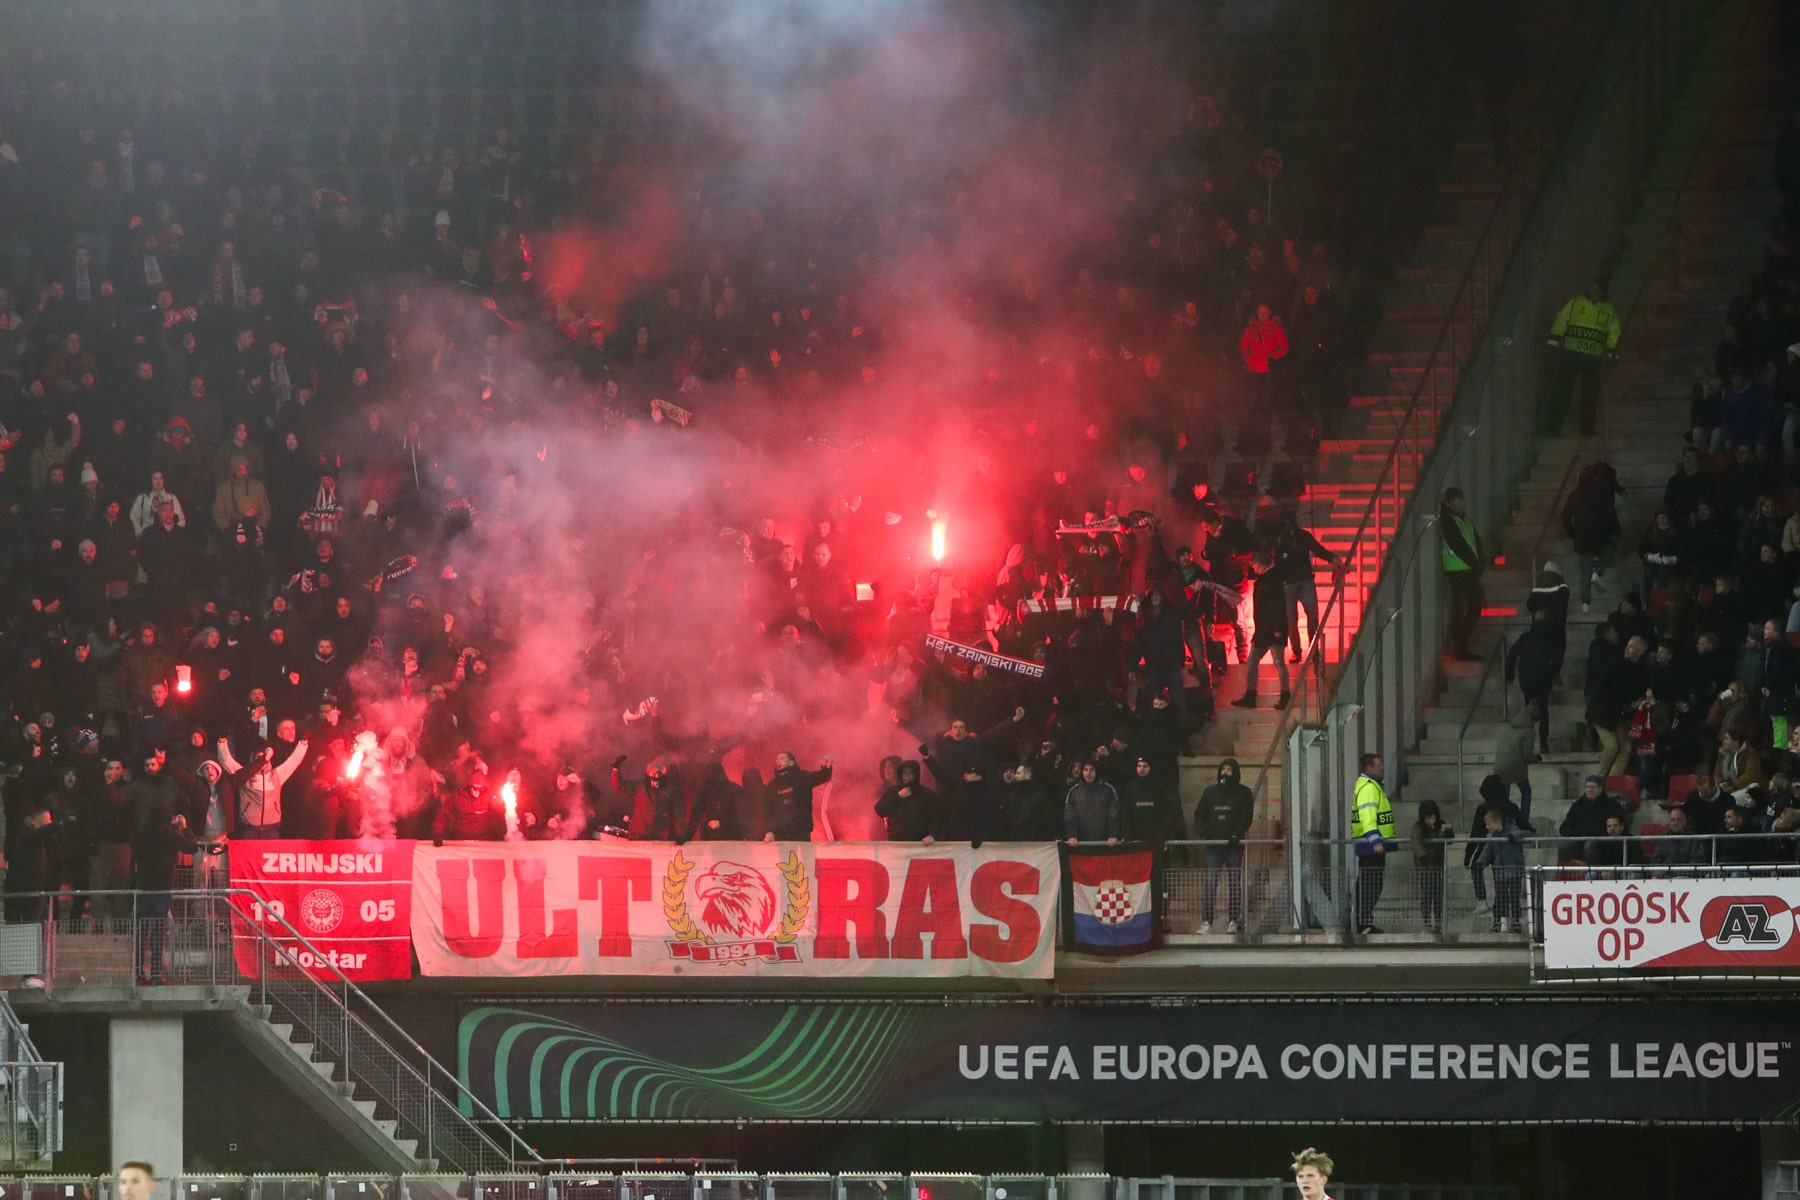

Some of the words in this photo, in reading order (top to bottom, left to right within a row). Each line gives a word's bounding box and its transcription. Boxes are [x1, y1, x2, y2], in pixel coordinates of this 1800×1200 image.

[1014, 663, 1044, 678] 1905
[262, 852, 383, 874] ZRINJSKI
[250, 900, 285, 922] 19
[360, 899, 395, 922] 05
[1551, 884, 1691, 925] GROÔSK
[1716, 902, 1780, 944] AZ
[708, 943, 757, 960] 1994
[1597, 927, 1645, 961] OP
[275, 947, 367, 969] Mostar
[958, 1044, 1080, 1080] UEFA
[1093, 1044, 1268, 1080] EUROPA
[1280, 1042, 1590, 1080] CONFERENCE
[1610, 1041, 1780, 1079] LEAGUE
